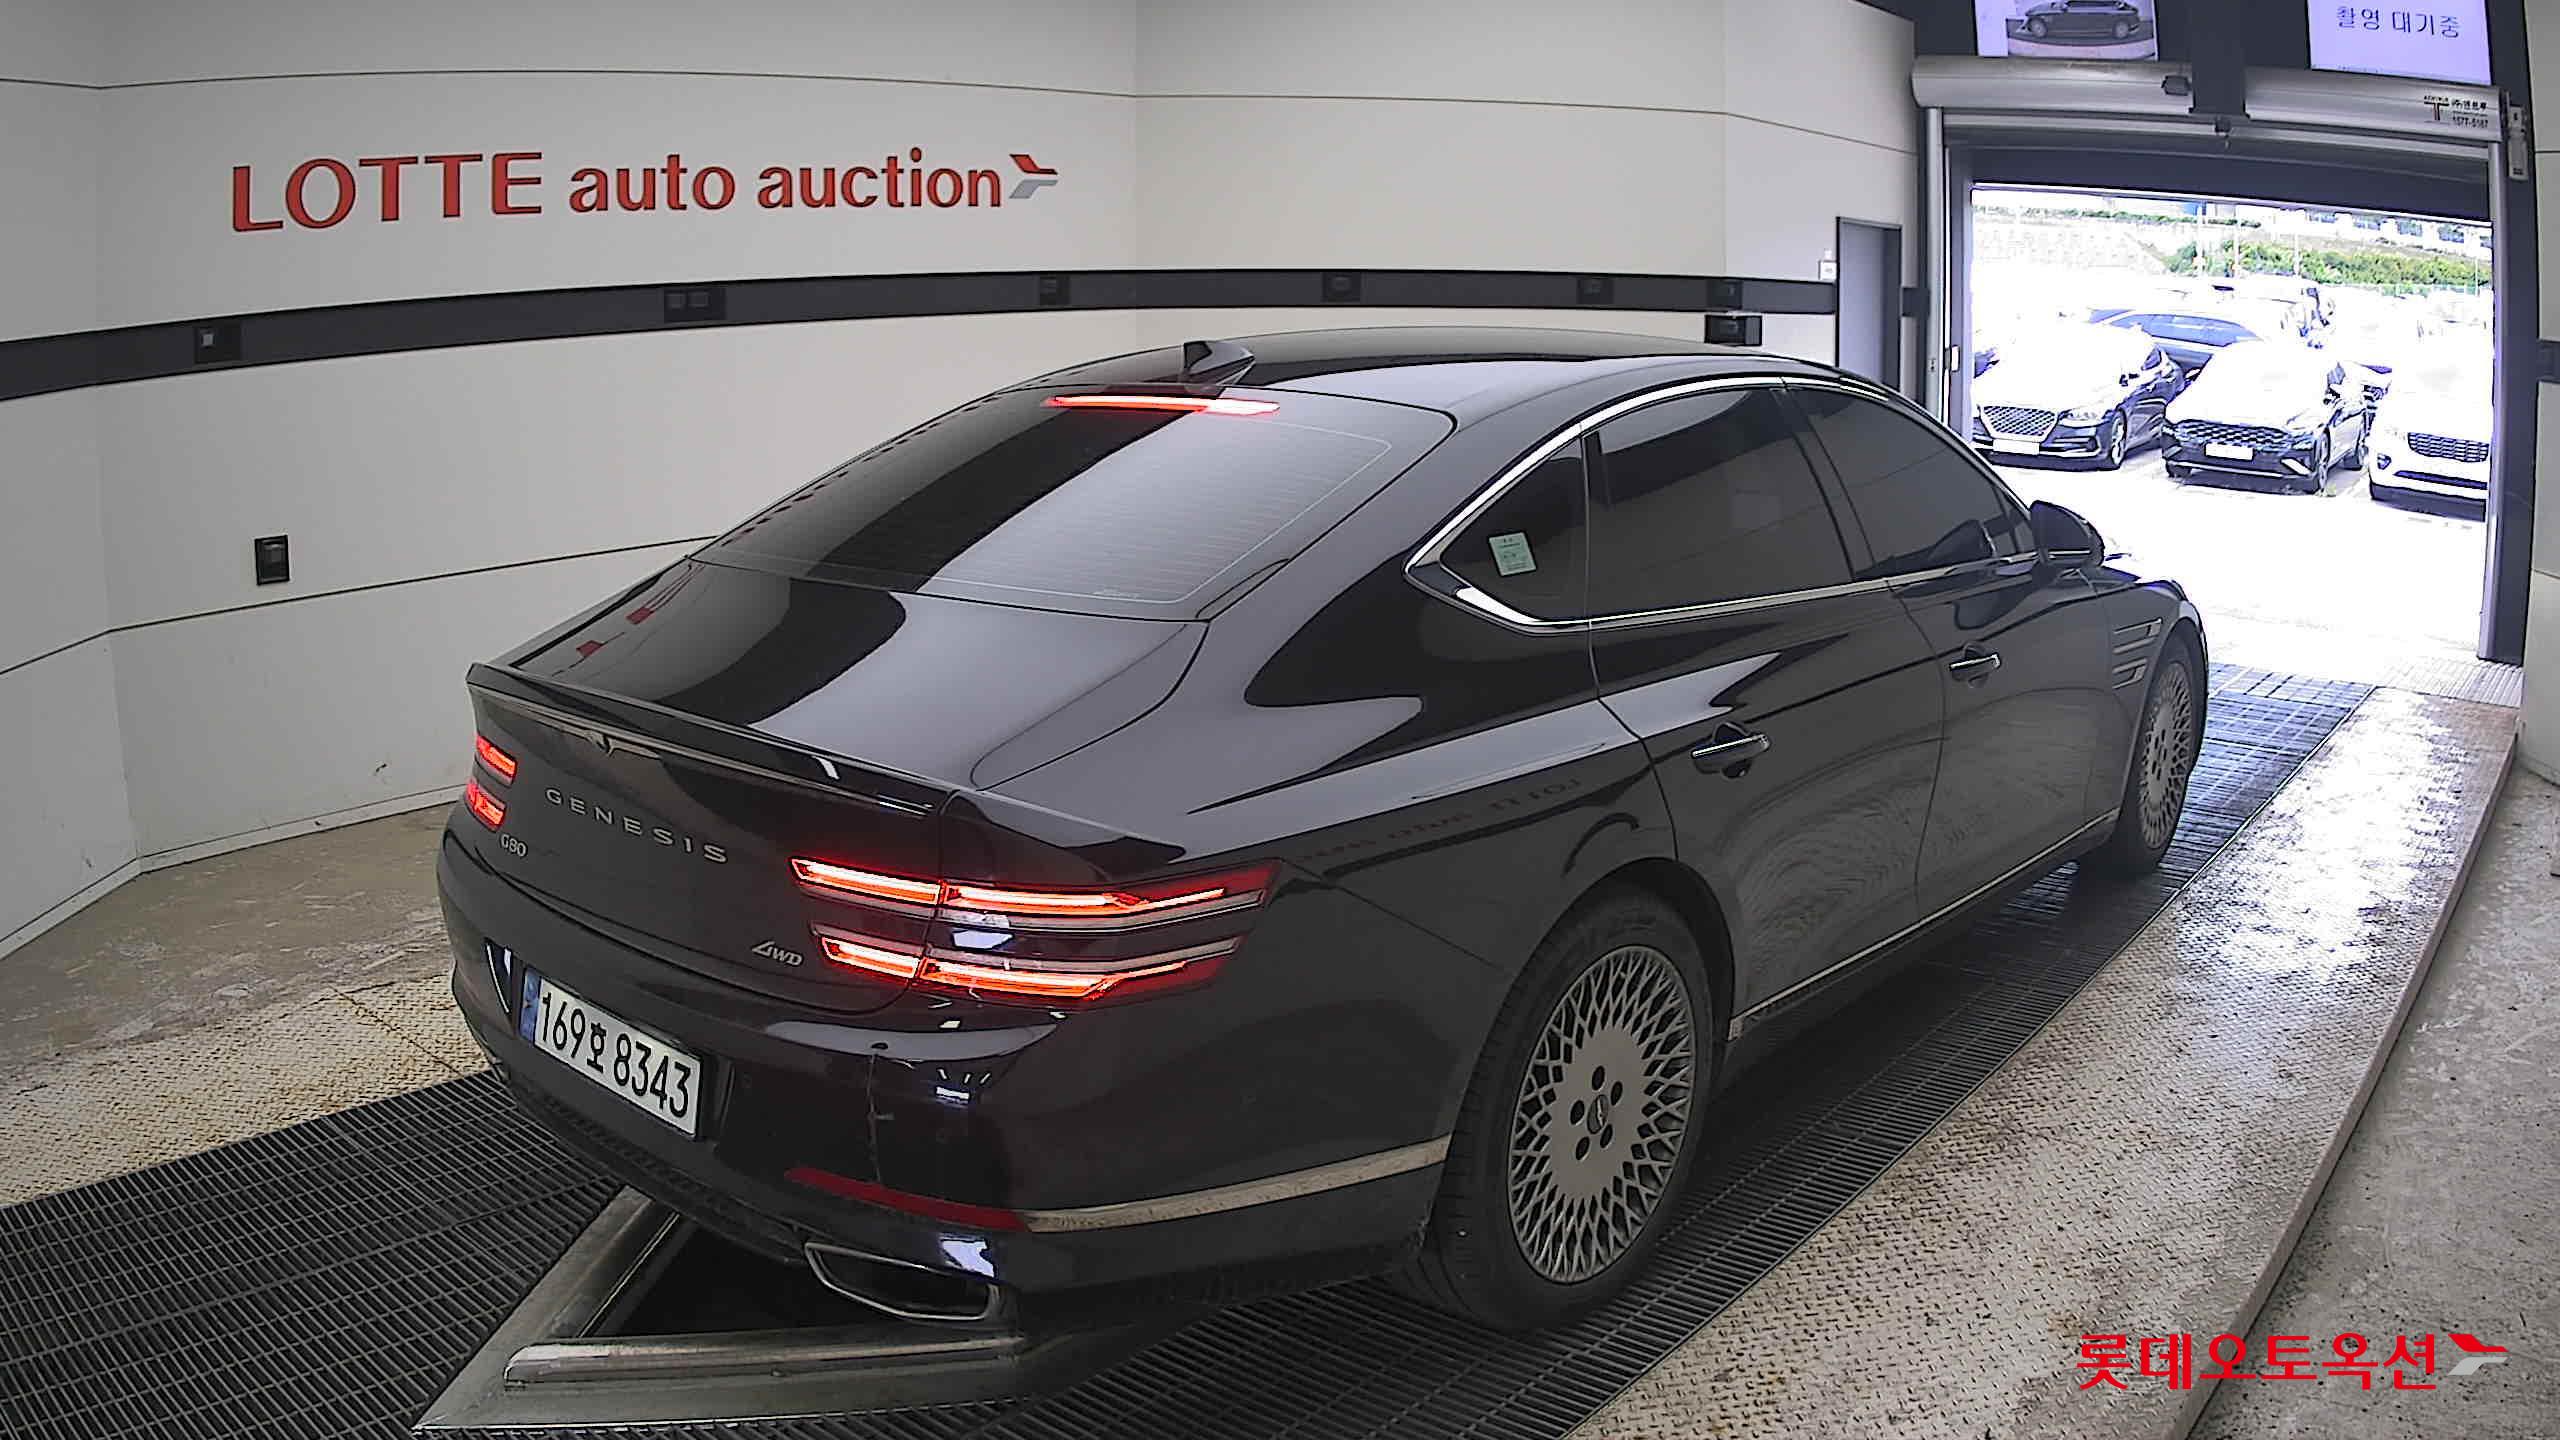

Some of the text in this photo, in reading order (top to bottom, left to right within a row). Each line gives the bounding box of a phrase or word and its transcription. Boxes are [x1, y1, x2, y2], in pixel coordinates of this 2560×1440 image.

[2336, 6, 2459, 39] 촬영 대기중
[232, 147, 1002, 232] LOTTE auto auction
[500, 833, 528, 858] G80
[545, 787, 729, 864] GENESIS
[613, 1032, 692, 1119] 8343
